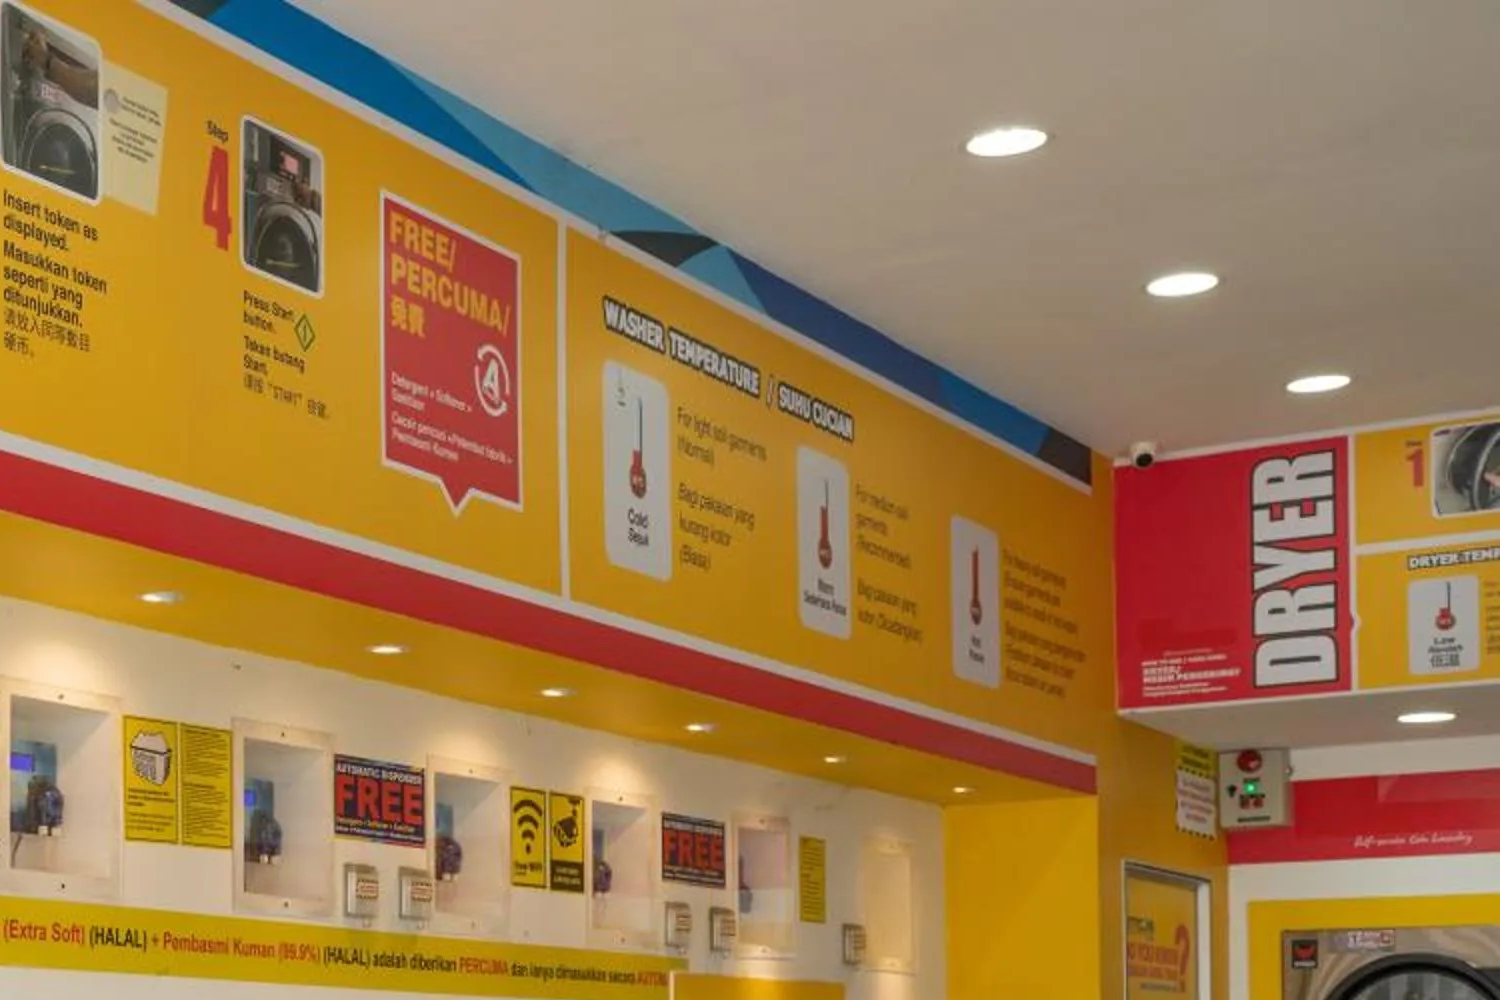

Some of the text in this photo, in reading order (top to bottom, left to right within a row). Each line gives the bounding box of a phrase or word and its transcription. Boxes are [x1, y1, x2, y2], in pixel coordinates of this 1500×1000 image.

[205, 120, 229, 143] Step
[3, 188, 98, 241] Insert token as
[203, 146, 231, 251] 4
[3, 214, 68, 251] displayed.
[390, 211, 457, 273] FREE/
[3, 239, 107, 294] Masukkan token
[3, 266, 83, 311] seperti yang
[391, 253, 511, 337] PERCUMA/
[603, 296, 665, 352] WASHER
[668, 327, 760, 398] TEMPERATURE
[779, 383, 811, 422] SUHU
[812, 400, 854, 441] CUCIAN
[1405, 449, 1424, 487] 1
[1252, 448, 1339, 688] DRYER
[336, 774, 423, 825] FREE
[663, 827, 725, 871] FREE
[3, 919, 47, 942] (Extra
[51, 923, 85, 946] Soft)
[89, 925, 148, 953] (HALAL)
[163, 930, 229, 955] Pembasmi
[233, 939, 275, 957] Kuman
[324, 946, 369, 969] (HALAL)
